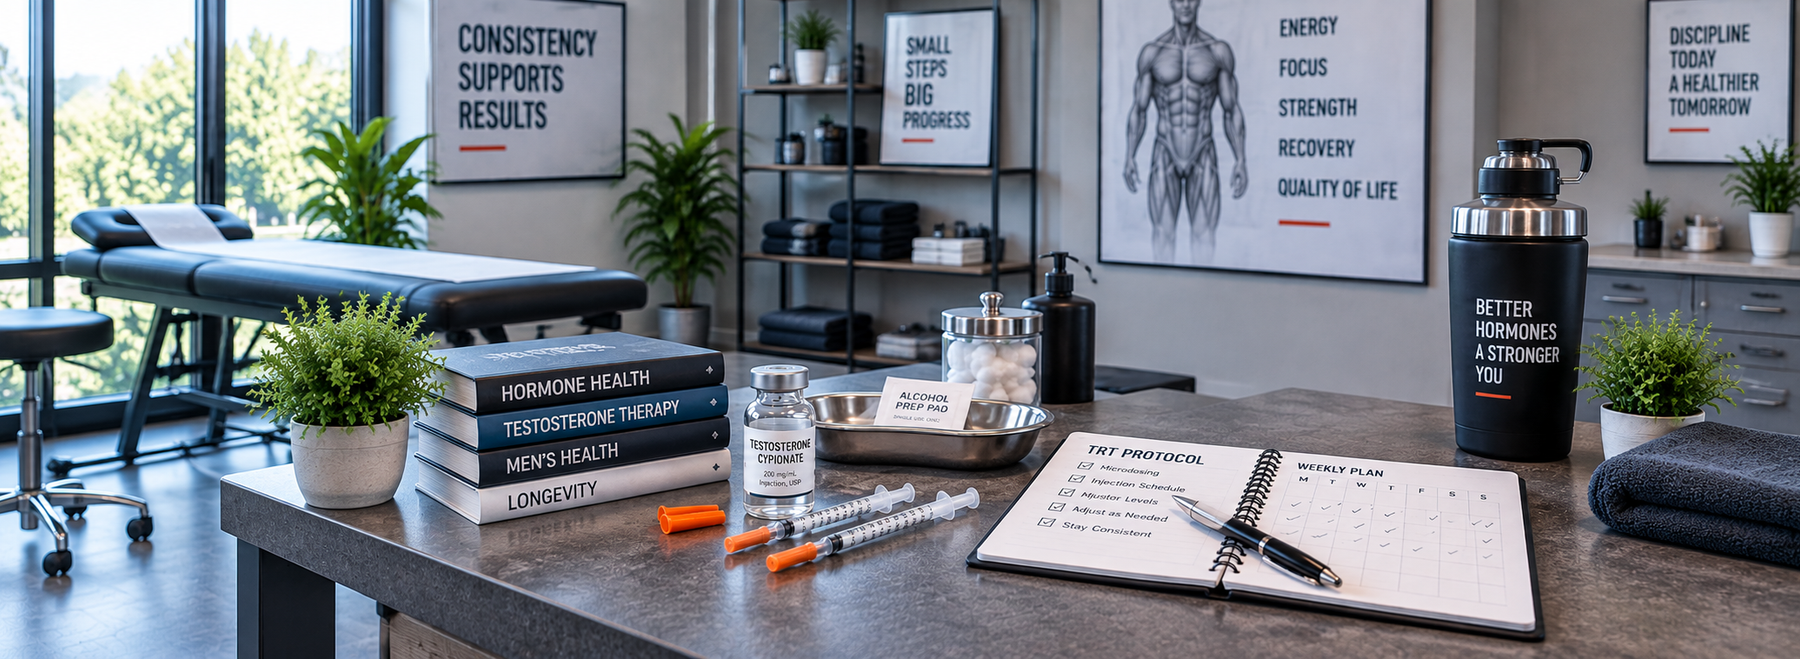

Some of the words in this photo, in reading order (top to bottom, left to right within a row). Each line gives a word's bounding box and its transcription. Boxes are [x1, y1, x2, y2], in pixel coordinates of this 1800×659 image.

[1280, 16, 1338, 37] ENERGY
[1670, 23, 1750, 45] DISCIPLINE
[458, 23, 597, 58] CONSISTENCY
[906, 35, 952, 56] SMALL
[905, 59, 947, 79] STEPS
[1279, 58, 1328, 77] FOCUS
[1669, 49, 1716, 69] TODAY
[458, 62, 565, 94] SUPPORTS
[1669, 74, 1678, 93] A
[1683, 73, 1759, 92] HEALTHIER
[904, 82, 934, 106] BIG
[459, 100, 547, 130] RESULTS
[1279, 98, 1357, 117] STRENGTH
[1669, 96, 1751, 117] TOMORROW
[903, 110, 971, 130] PROGRESS
[1279, 138, 1355, 158] RECOVERY
[1278, 178, 1339, 198] QUALITY
[1343, 180, 1362, 199] OF
[1367, 181, 1398, 200] LIFE
[1476, 298, 1533, 318] BETTER
[1476, 320, 1557, 341] HORMONES
[1475, 343, 1484, 360] A
[1487, 344, 1560, 363] STRONGER
[1475, 365, 1503, 384] YOU
[502, 376, 586, 402] HORMONE
[590, 369, 650, 392] HEALTH
[895, 401, 925, 411] PREP
[926, 404, 949, 413] PAD
[899, 391, 949, 403] ALCOHOL
[503, 408, 616, 438] TESTOSTERONE
[618, 399, 680, 421] THERAPY
[560, 442, 619, 466] HEALTH
[749, 438, 810, 451] TESTOSTERONE
[1087, 444, 1119, 457] TRT
[1121, 448, 1205, 465] PROTOCOL
[757, 453, 803, 464] CYPIONATE
[1100, 465, 1160, 477] Microdosing
[1297, 462, 1347, 475] WEEKLY
[1349, 467, 1384, 478] PLAN
[508, 480, 598, 511] LONGEVITY
[1091, 477, 1135, 489] Injection
[1138, 482, 1186, 494] Schedule
[1124, 496, 1159, 506] Levels
[1072, 505, 1106, 516] Adjust
[1124, 511, 1169, 523] Needed
[1062, 521, 1088, 533] Stay
[1092, 525, 1153, 538] Consistent
